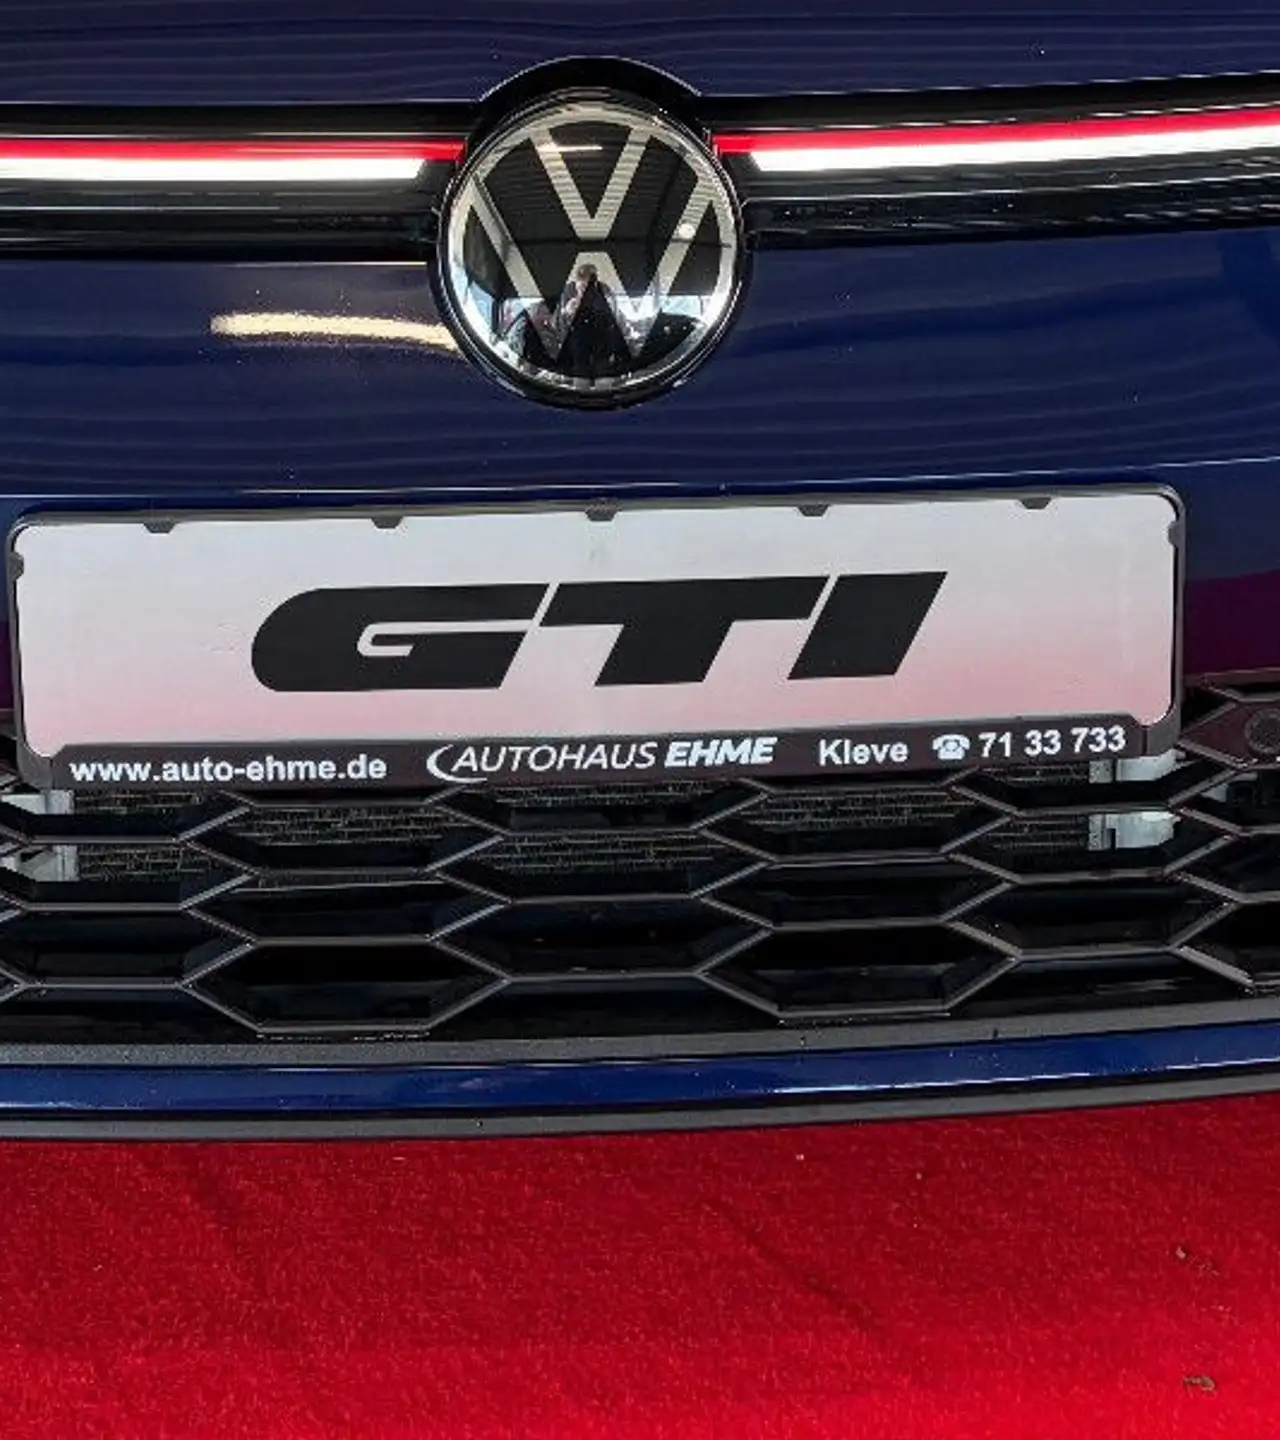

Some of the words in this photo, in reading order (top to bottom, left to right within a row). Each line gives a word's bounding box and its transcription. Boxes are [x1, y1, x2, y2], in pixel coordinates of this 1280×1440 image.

[446, 103, 740, 391] VW
[250, 571, 949, 692] GTI
[70, 753, 387, 782] www.auto-ehme.de
[451, 741, 658, 772] AUTOHAUS
[664, 737, 778, 768] EHME
[819, 738, 909, 766] Kleve
[979, 732, 1013, 758] 71
[1024, 729, 1062, 756] 33
[1070, 725, 1126, 753] 733
